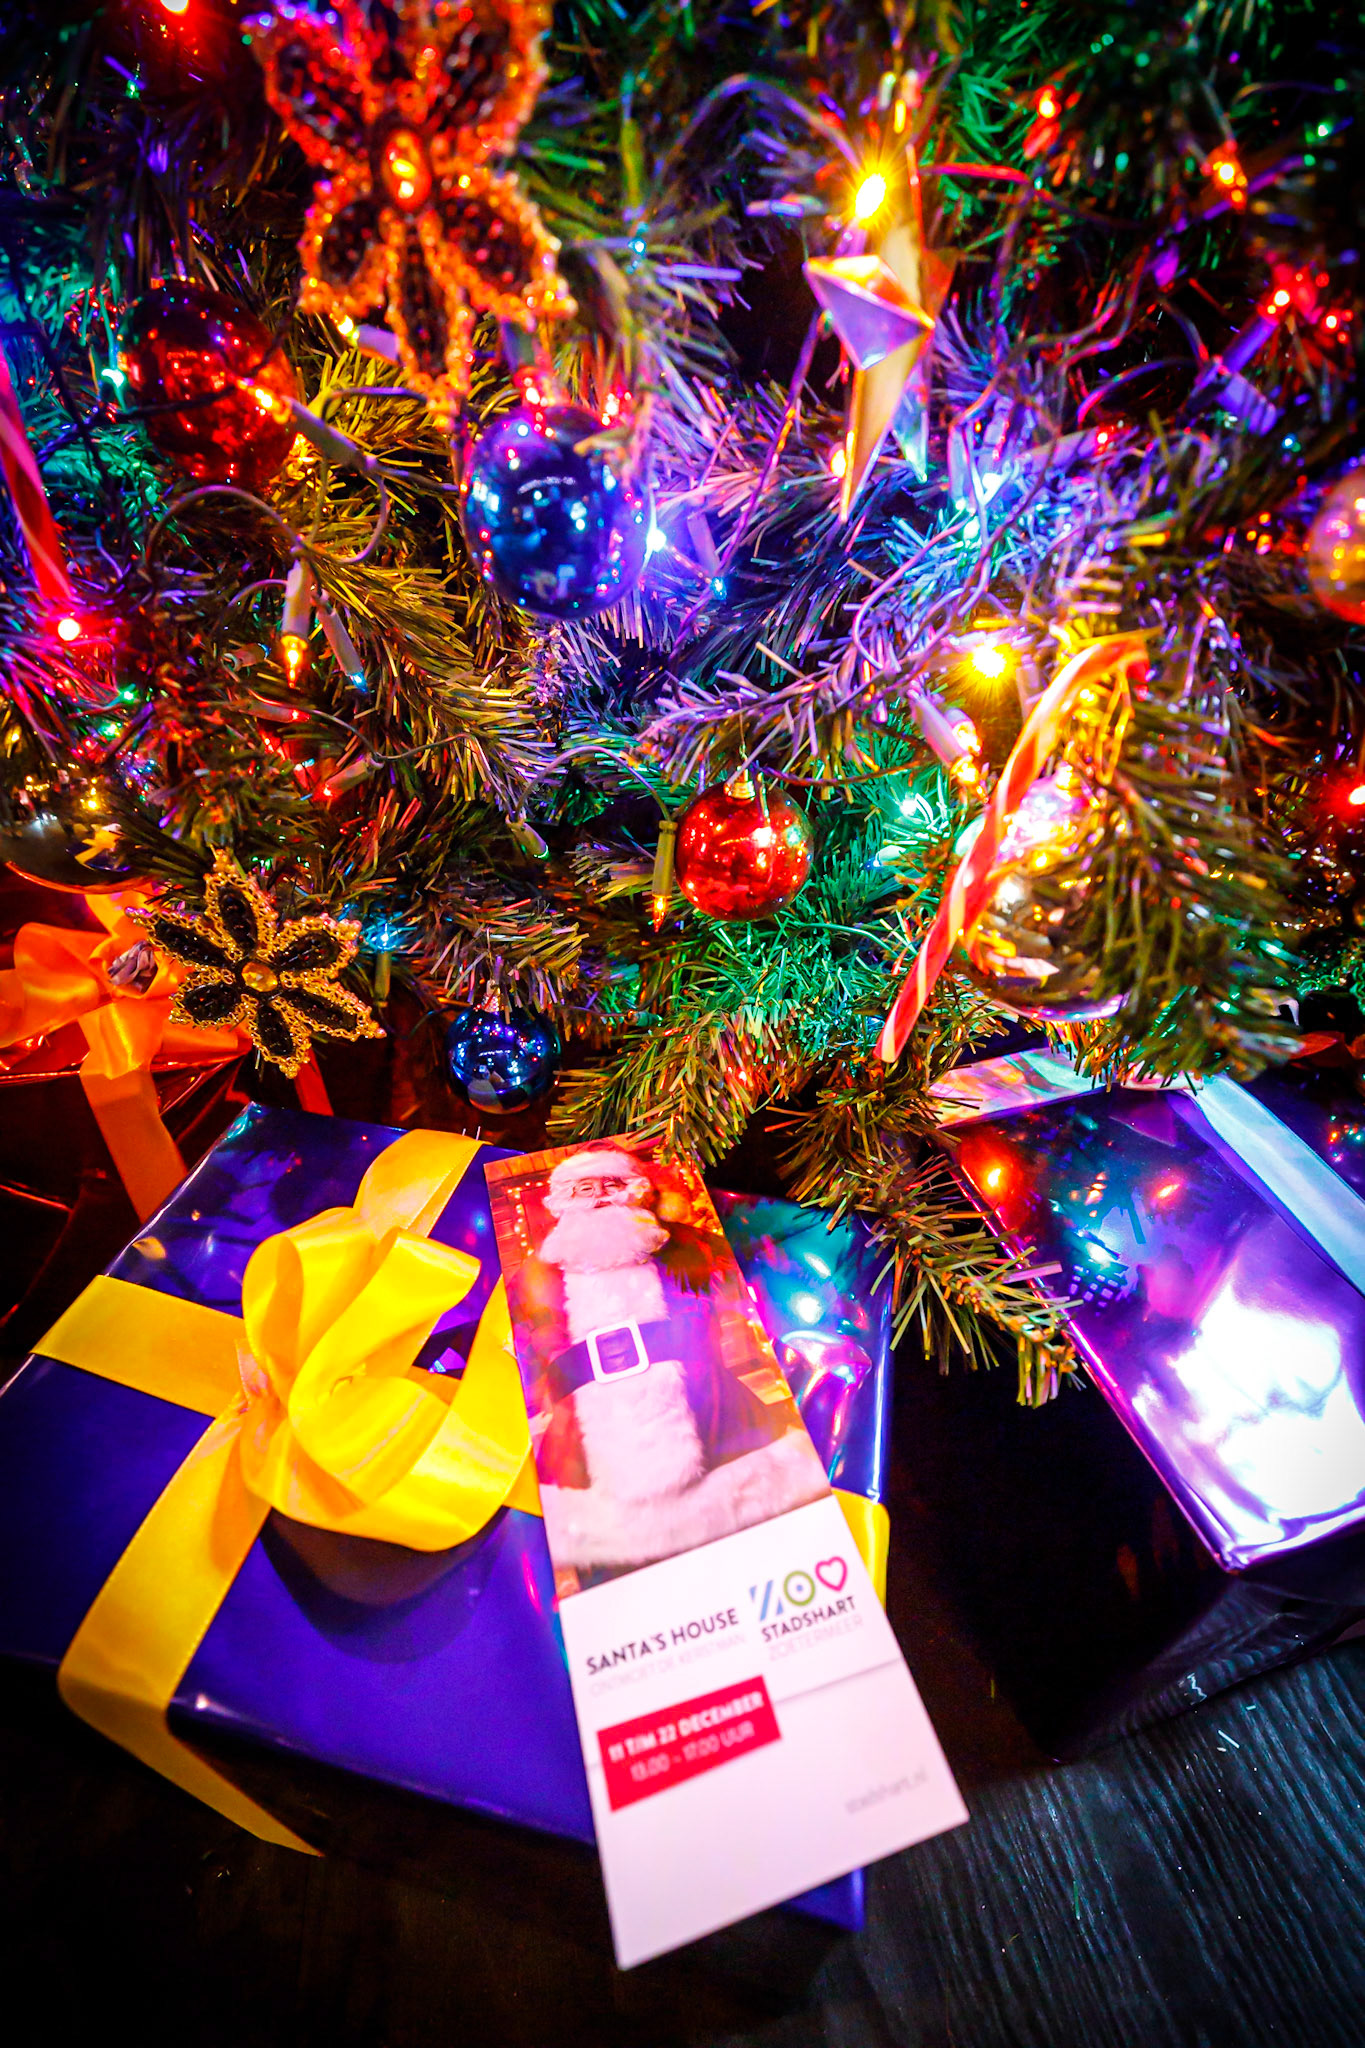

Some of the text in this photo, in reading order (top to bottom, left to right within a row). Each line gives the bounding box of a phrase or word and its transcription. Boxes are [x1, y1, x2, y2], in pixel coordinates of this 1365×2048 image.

[586, 1608, 739, 1676] SANTA'S HOUSE
[761, 1596, 857, 1643] STADSHART
[657, 1723, 677, 1745] 22
[678, 1691, 764, 1737] DECEMBER
[720, 1720, 755, 1747] UUR
